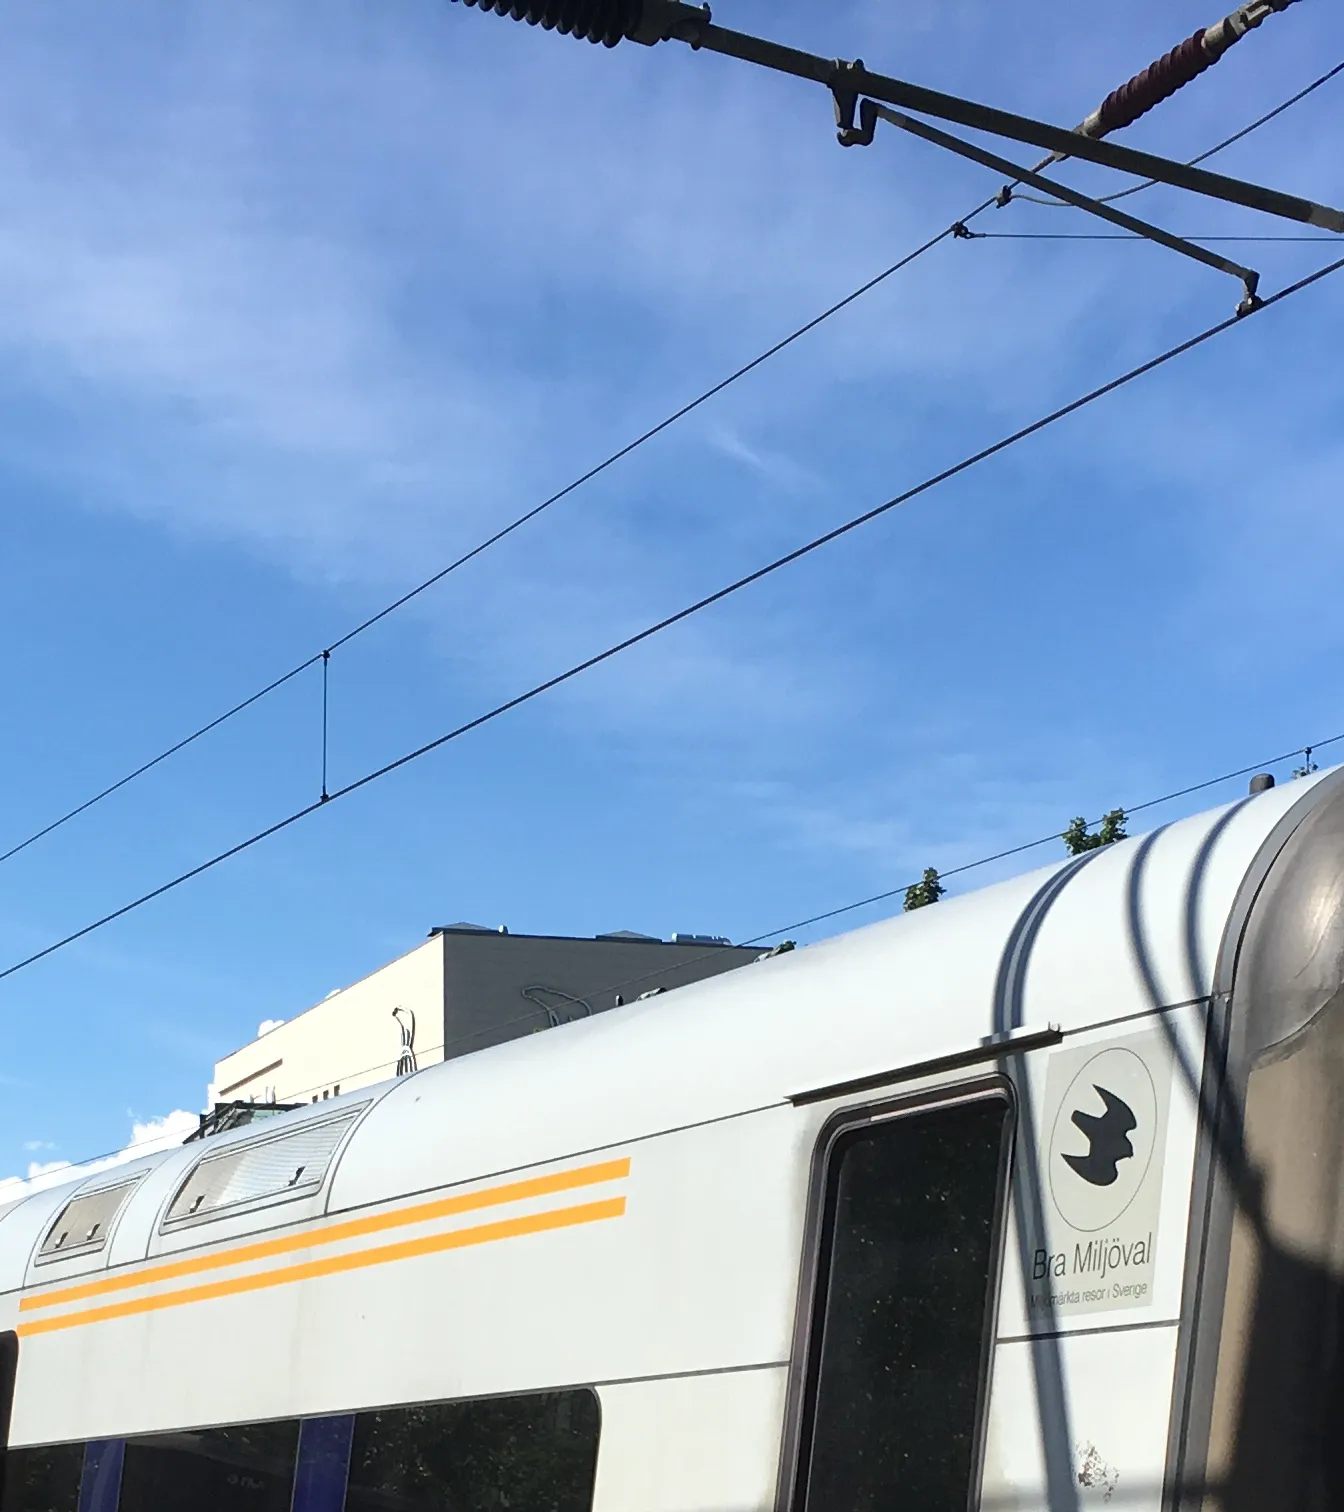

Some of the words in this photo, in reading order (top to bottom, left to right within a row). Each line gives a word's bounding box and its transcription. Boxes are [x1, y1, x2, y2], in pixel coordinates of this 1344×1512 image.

[1033, 1249, 1066, 1280] Bra
[1073, 1231, 1152, 1279] Miljöval
[1082, 1288, 1106, 1303] resor
[1112, 1283, 1148, 1299] Sverige
